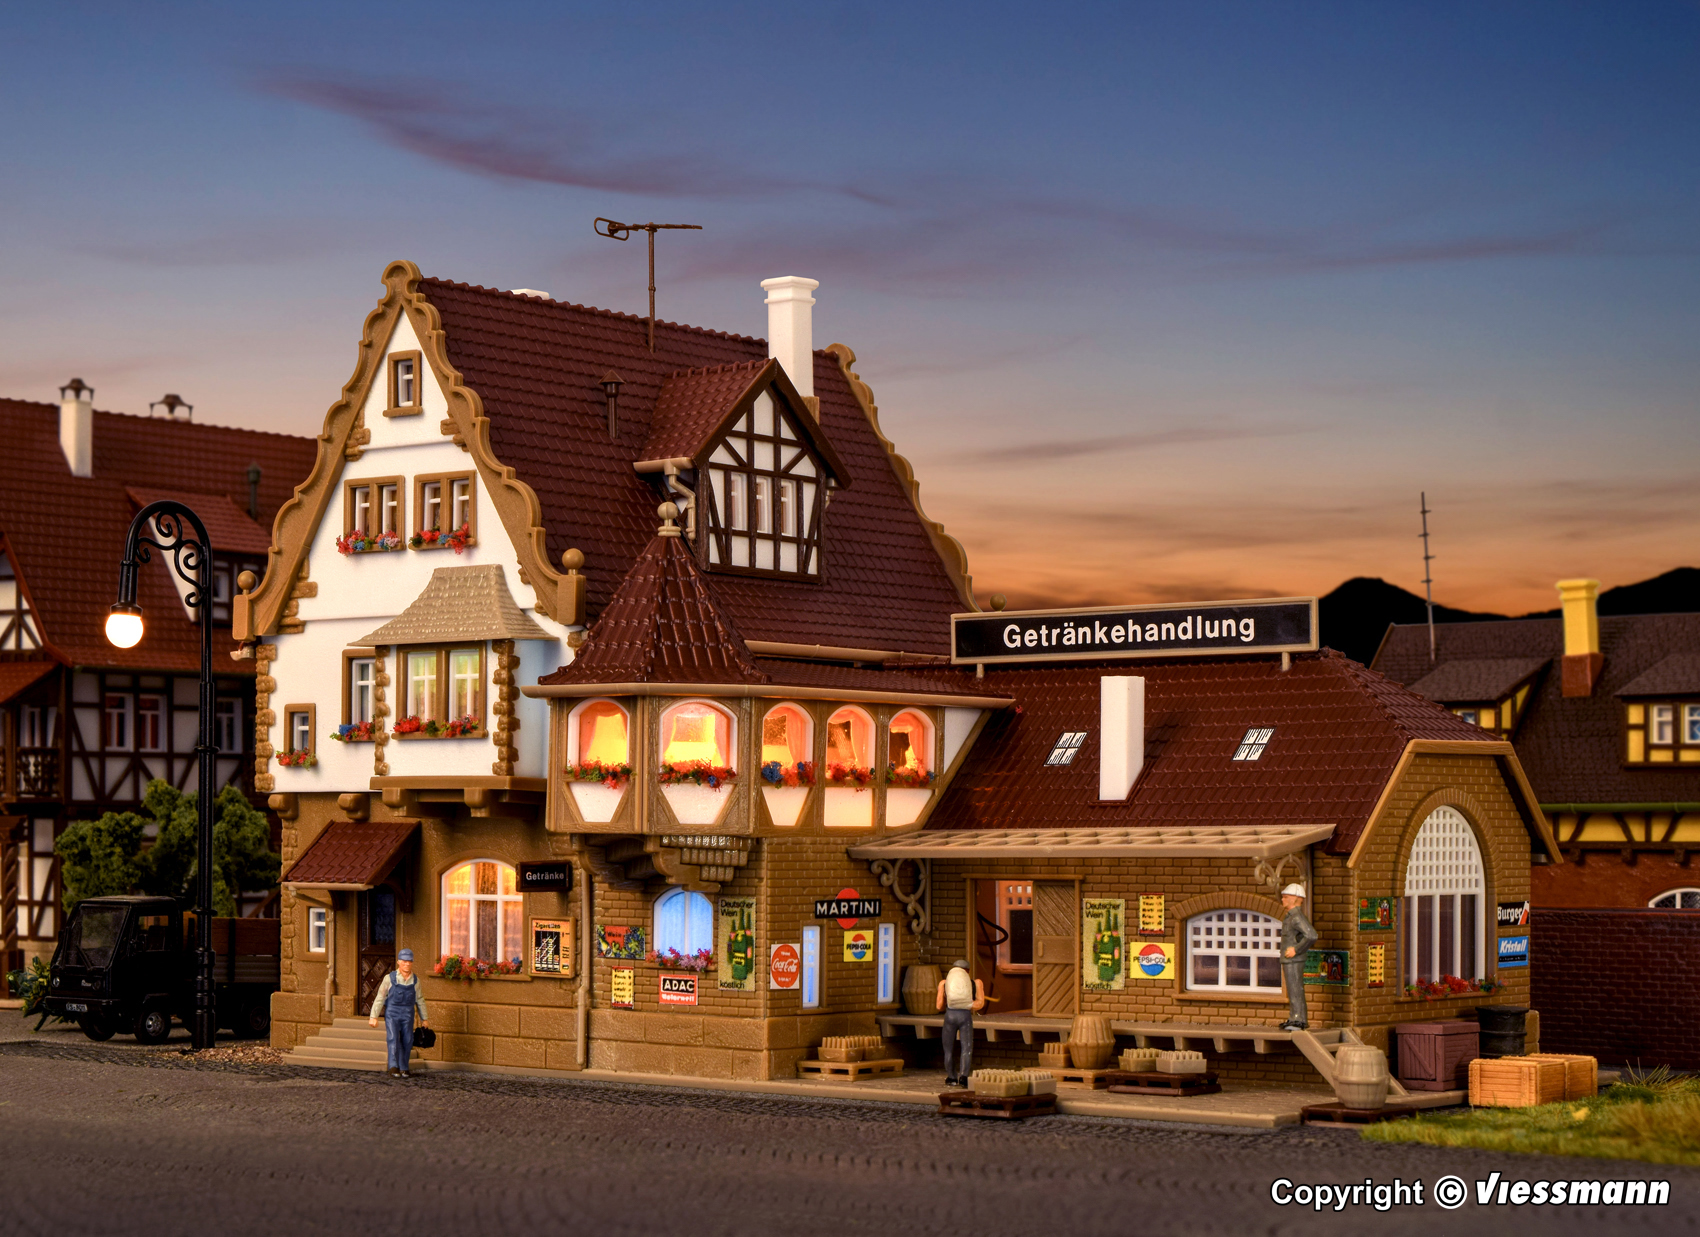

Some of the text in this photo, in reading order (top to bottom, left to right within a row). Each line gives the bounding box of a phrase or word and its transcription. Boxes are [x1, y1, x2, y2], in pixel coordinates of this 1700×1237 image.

[1003, 615, 1255, 648] Getränkehandlung
[525, 871, 565, 881] Getränke
[720, 899, 754, 909] Deutscher
[816, 901, 879, 915] MARTINI
[1085, 902, 1121, 911] Deutscher
[721, 908, 738, 917] Wein
[1085, 910, 1104, 919] Wein
[1500, 939, 1528, 953] Kristall
[1133, 956, 1171, 964] PEPSI-COLA
[664, 979, 695, 992] ADAC
[720, 980, 745, 989] köstlich
[1085, 981, 1112, 990] köstlich
